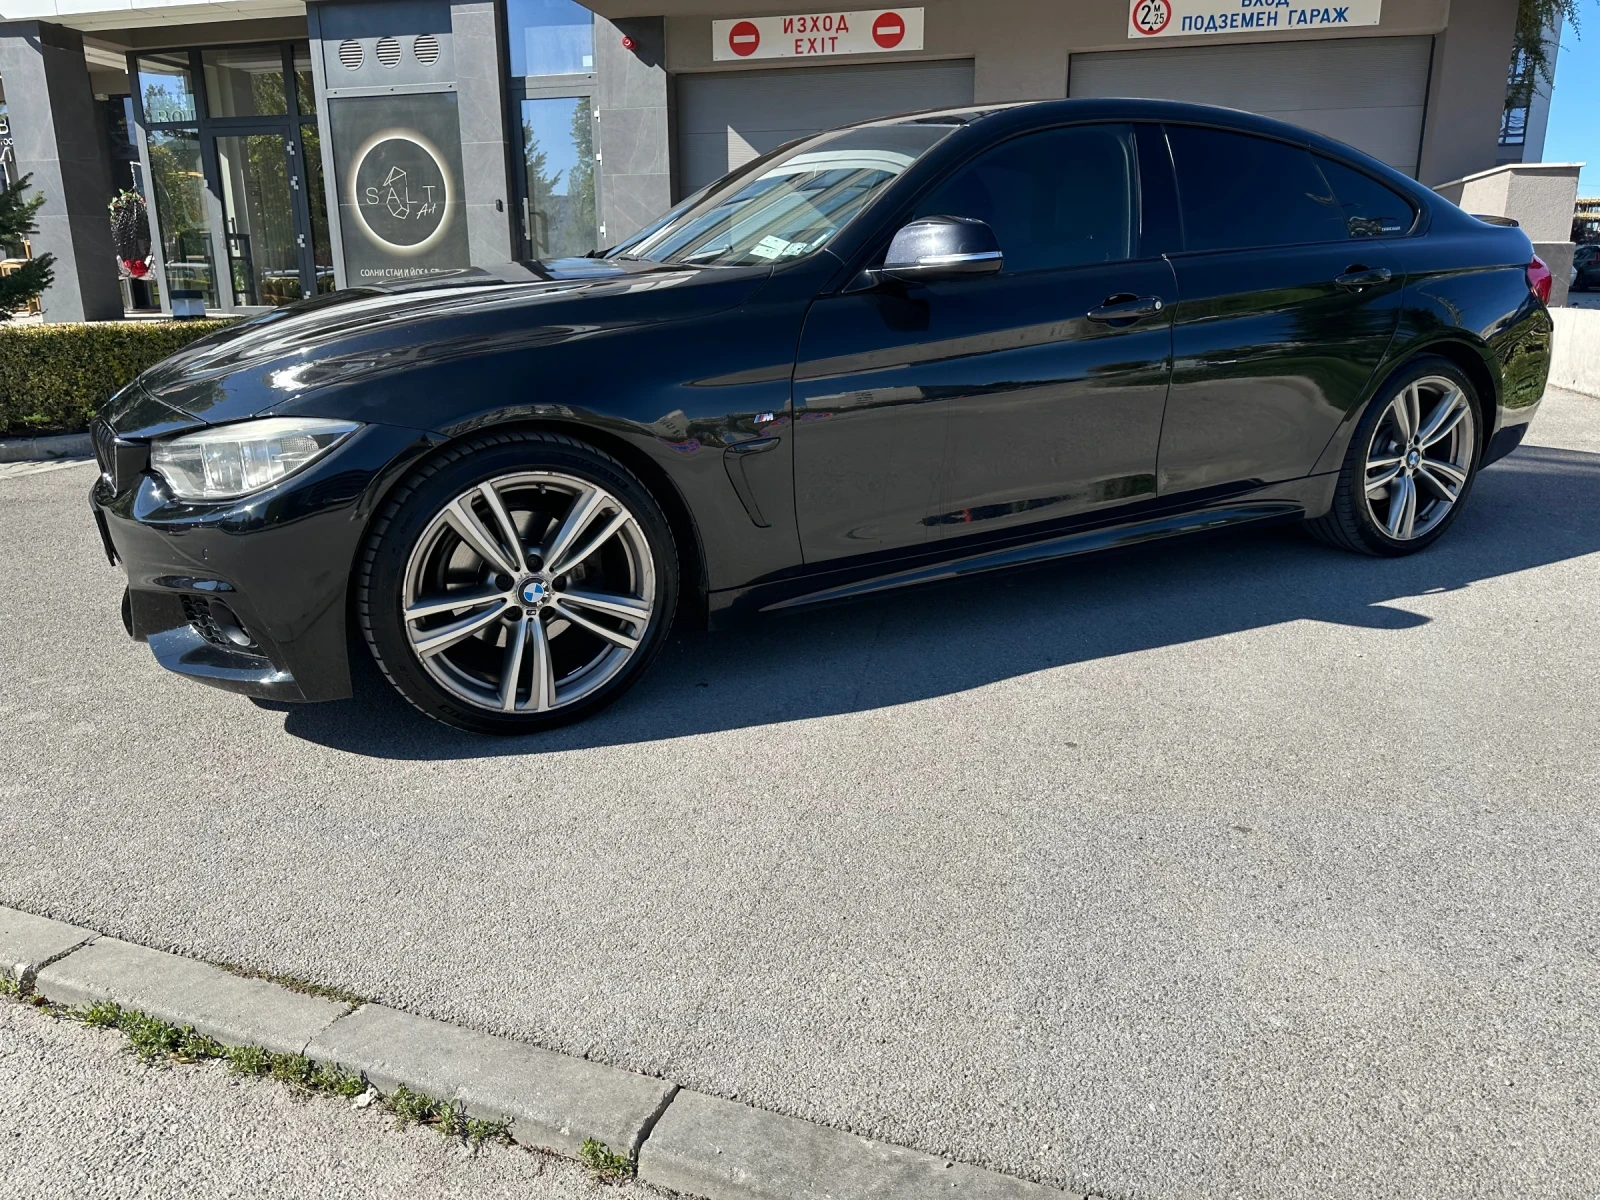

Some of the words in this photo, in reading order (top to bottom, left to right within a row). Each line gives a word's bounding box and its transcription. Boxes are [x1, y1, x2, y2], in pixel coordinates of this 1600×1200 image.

[783, 14, 849, 34] ИЗХОД
[1181, 11, 1278, 32] ПОДЗЕМЕН
[1288, 6, 1350, 26] ГАРАЖ
[794, 36, 838, 54] EXIT
[366, 184, 436, 205] SALT
[416, 203, 437, 220] Art
[360, 268, 385, 277] СОЛНИ
[385, 268, 404, 277] СТАИ
